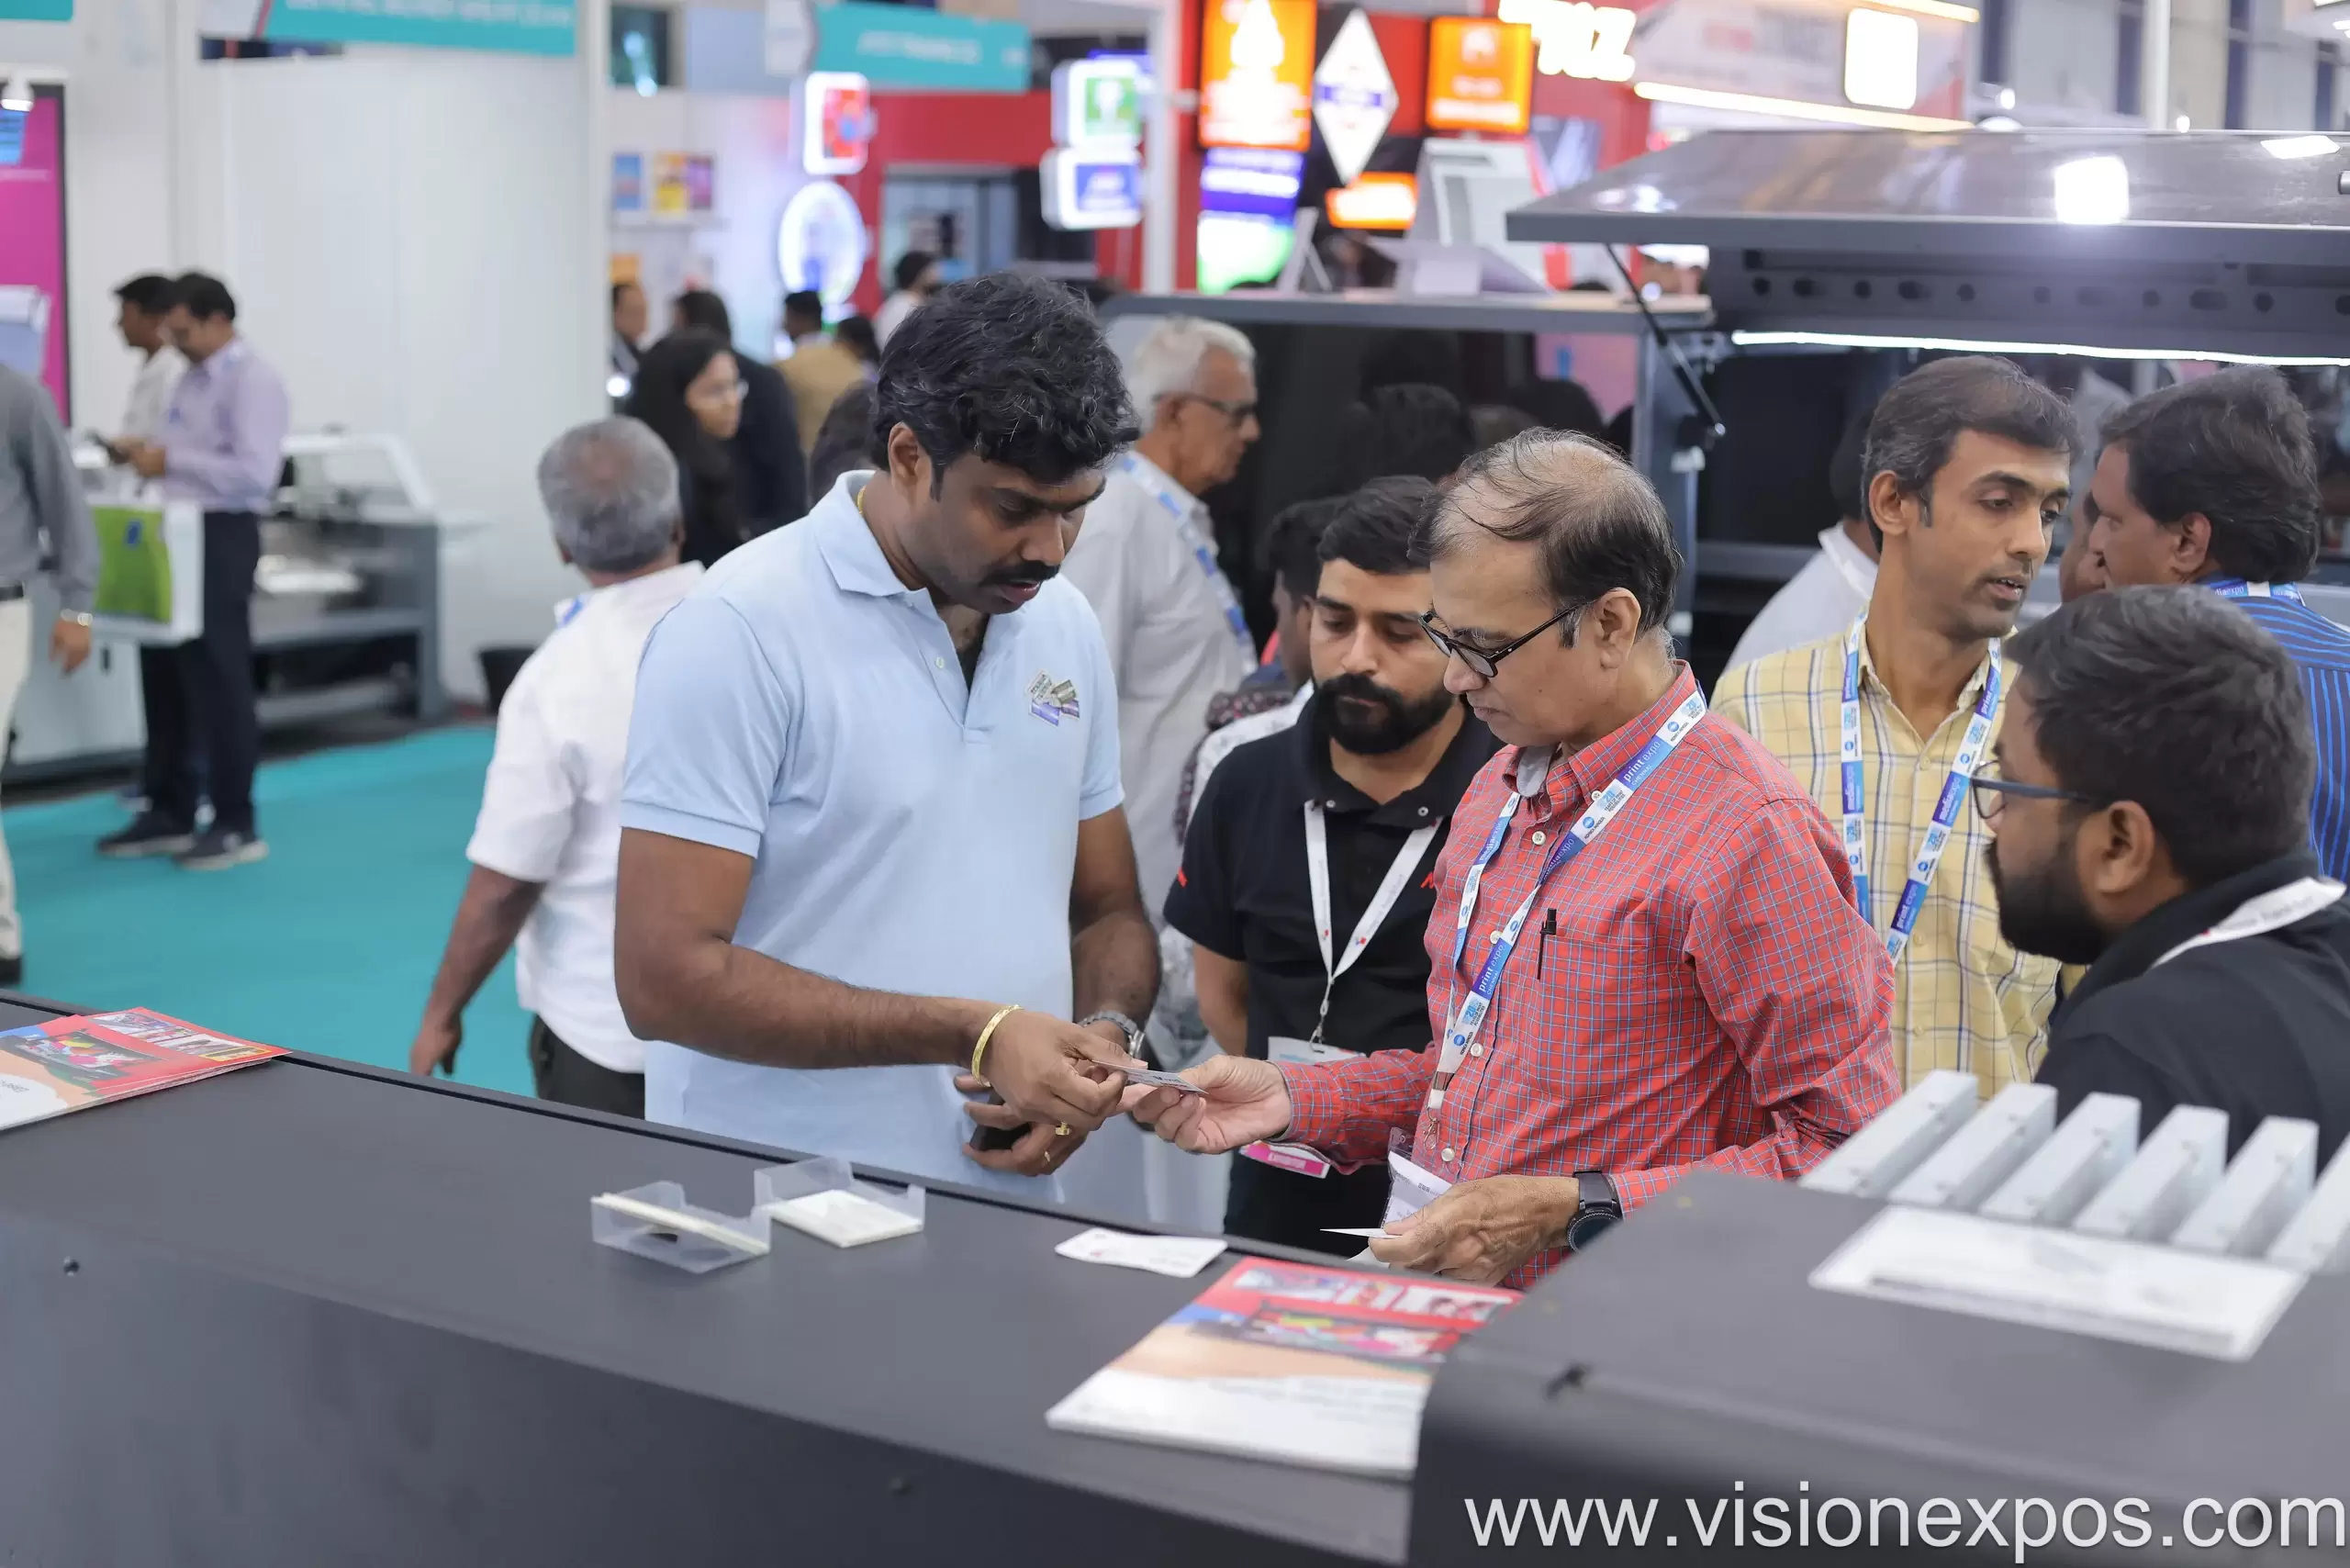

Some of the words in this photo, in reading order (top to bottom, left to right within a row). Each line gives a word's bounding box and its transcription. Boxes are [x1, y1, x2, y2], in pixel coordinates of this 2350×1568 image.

[1624, 759, 1644, 782] print
[1642, 742, 1660, 760] expo
[1631, 765, 1652, 786] CHENNAI
[1602, 789, 1615, 802] 20
[1604, 801, 1613, 811] YEARS
[1583, 826, 1595, 839] KONICA
[1593, 816, 1605, 829] MINOLTA
[1479, 967, 1494, 992] print
[1491, 945, 1504, 967] expo
[1487, 970, 1498, 995] CHENNAI
[1464, 1004, 1476, 1017] 20
[1459, 1043, 1467, 1055] KONICA
